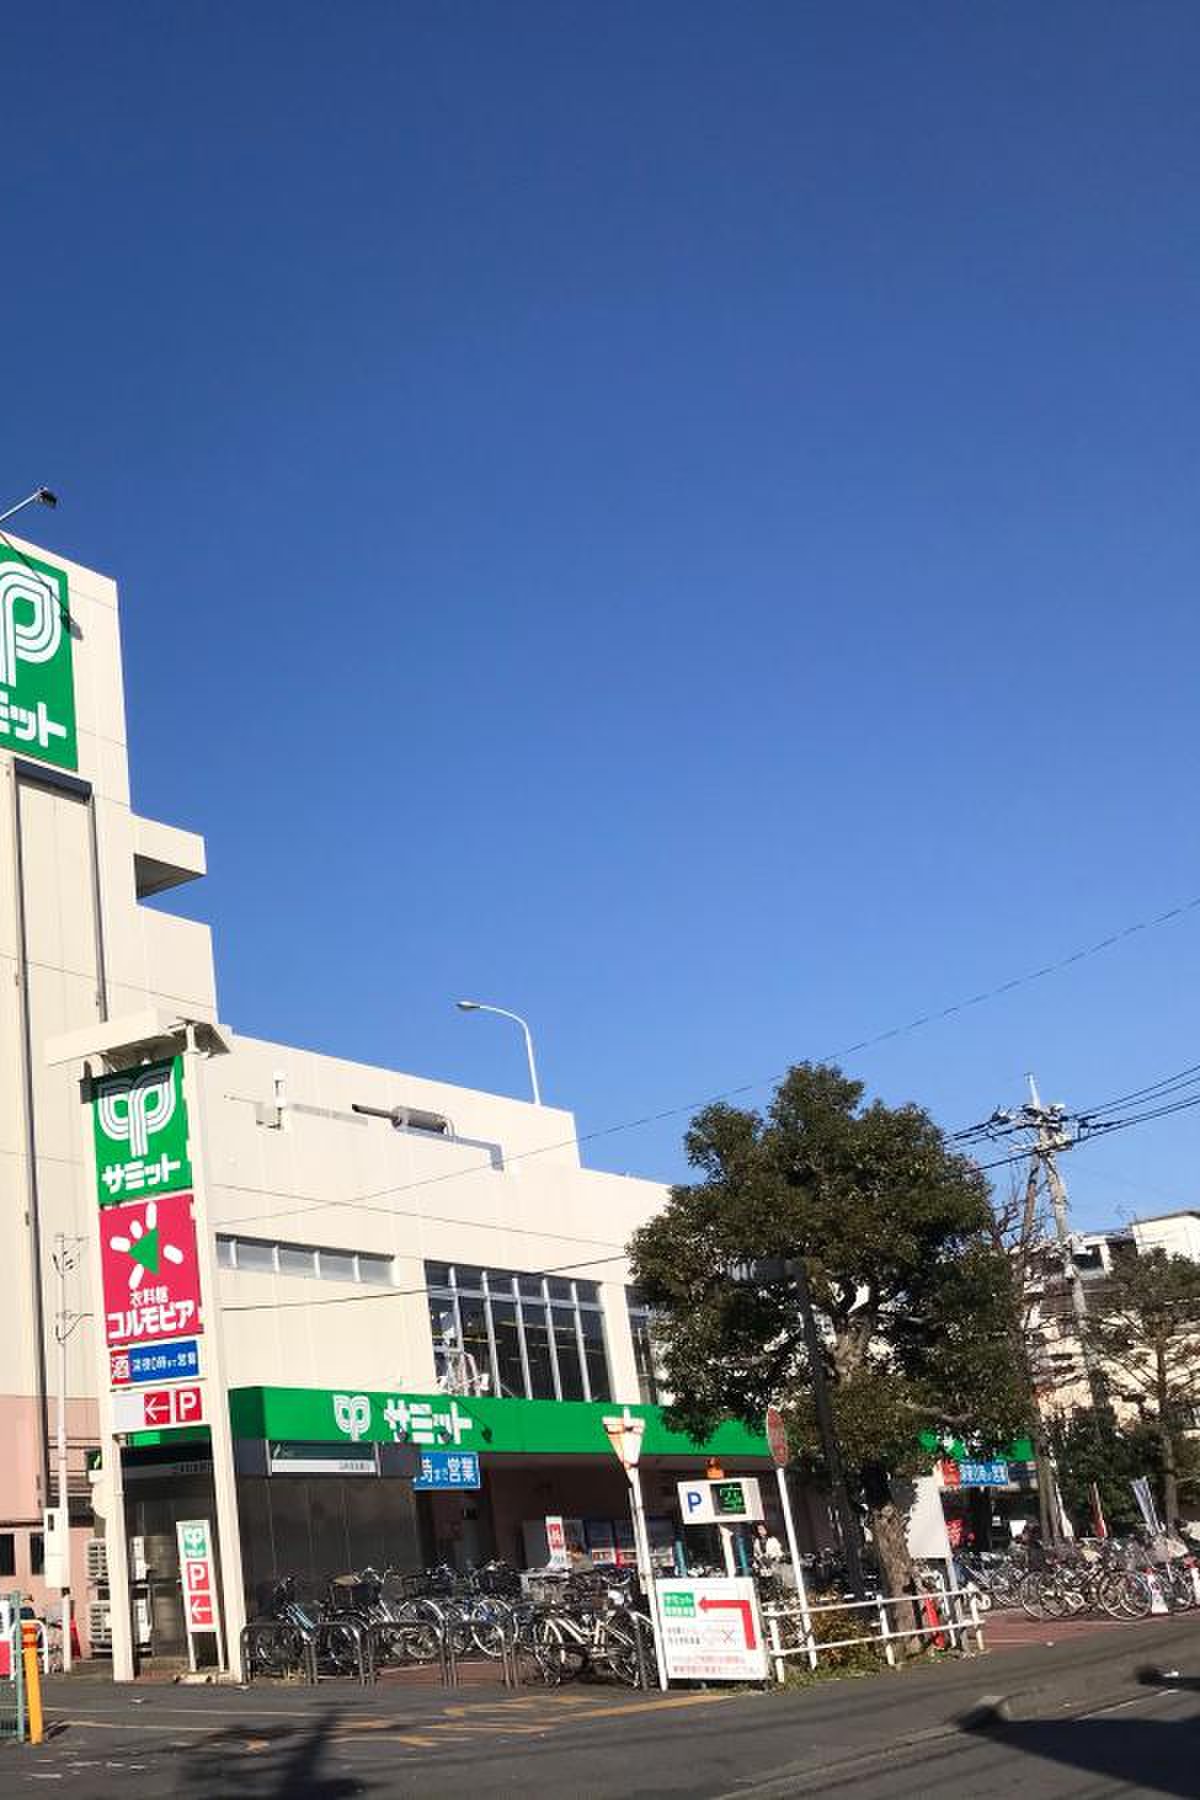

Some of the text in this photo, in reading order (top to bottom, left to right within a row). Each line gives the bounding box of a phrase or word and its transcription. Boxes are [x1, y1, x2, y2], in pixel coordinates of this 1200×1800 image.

[102, 1153, 181, 1193] サミット
[107, 1300, 195, 1339] コルモピア
[179, 1392, 197, 1420] P
[383, 1399, 473, 1445] サミット
[687, 1492, 702, 1513] P
[189, 1564, 206, 1589] P
